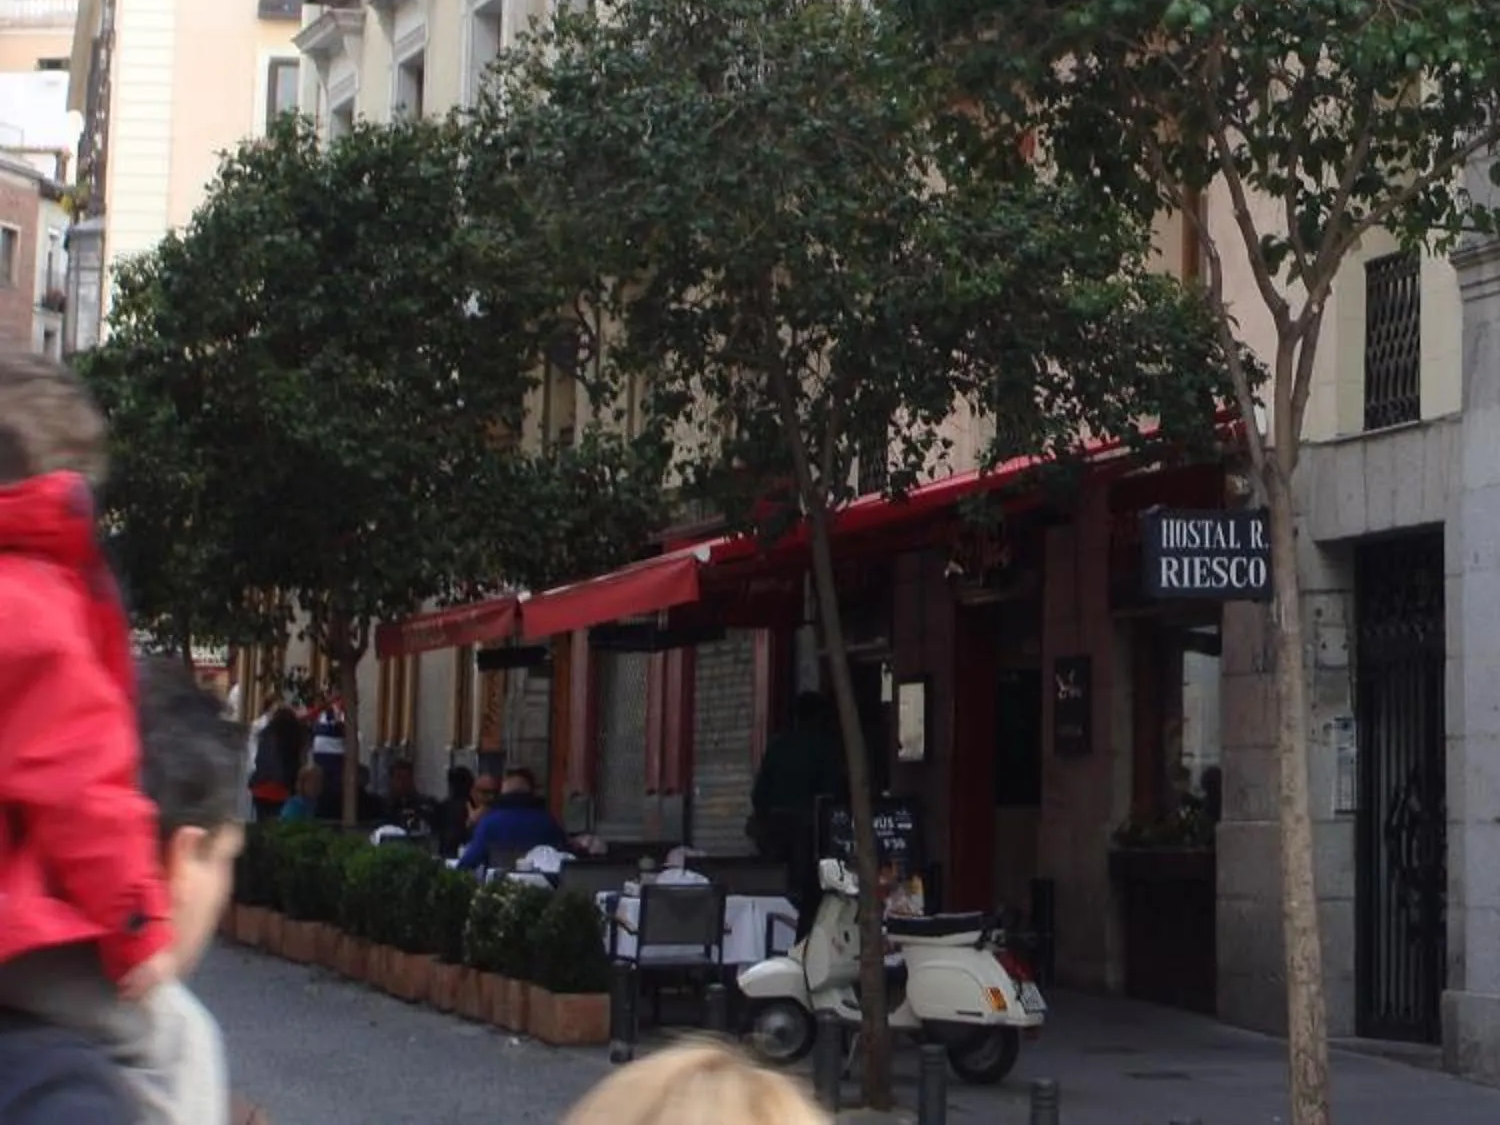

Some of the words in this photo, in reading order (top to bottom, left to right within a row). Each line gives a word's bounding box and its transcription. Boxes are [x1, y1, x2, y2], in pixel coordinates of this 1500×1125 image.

[1161, 518, 1241, 549] HOSTAL
[1250, 518, 1270, 550] R.
[1160, 555, 1267, 589] RIESCO
